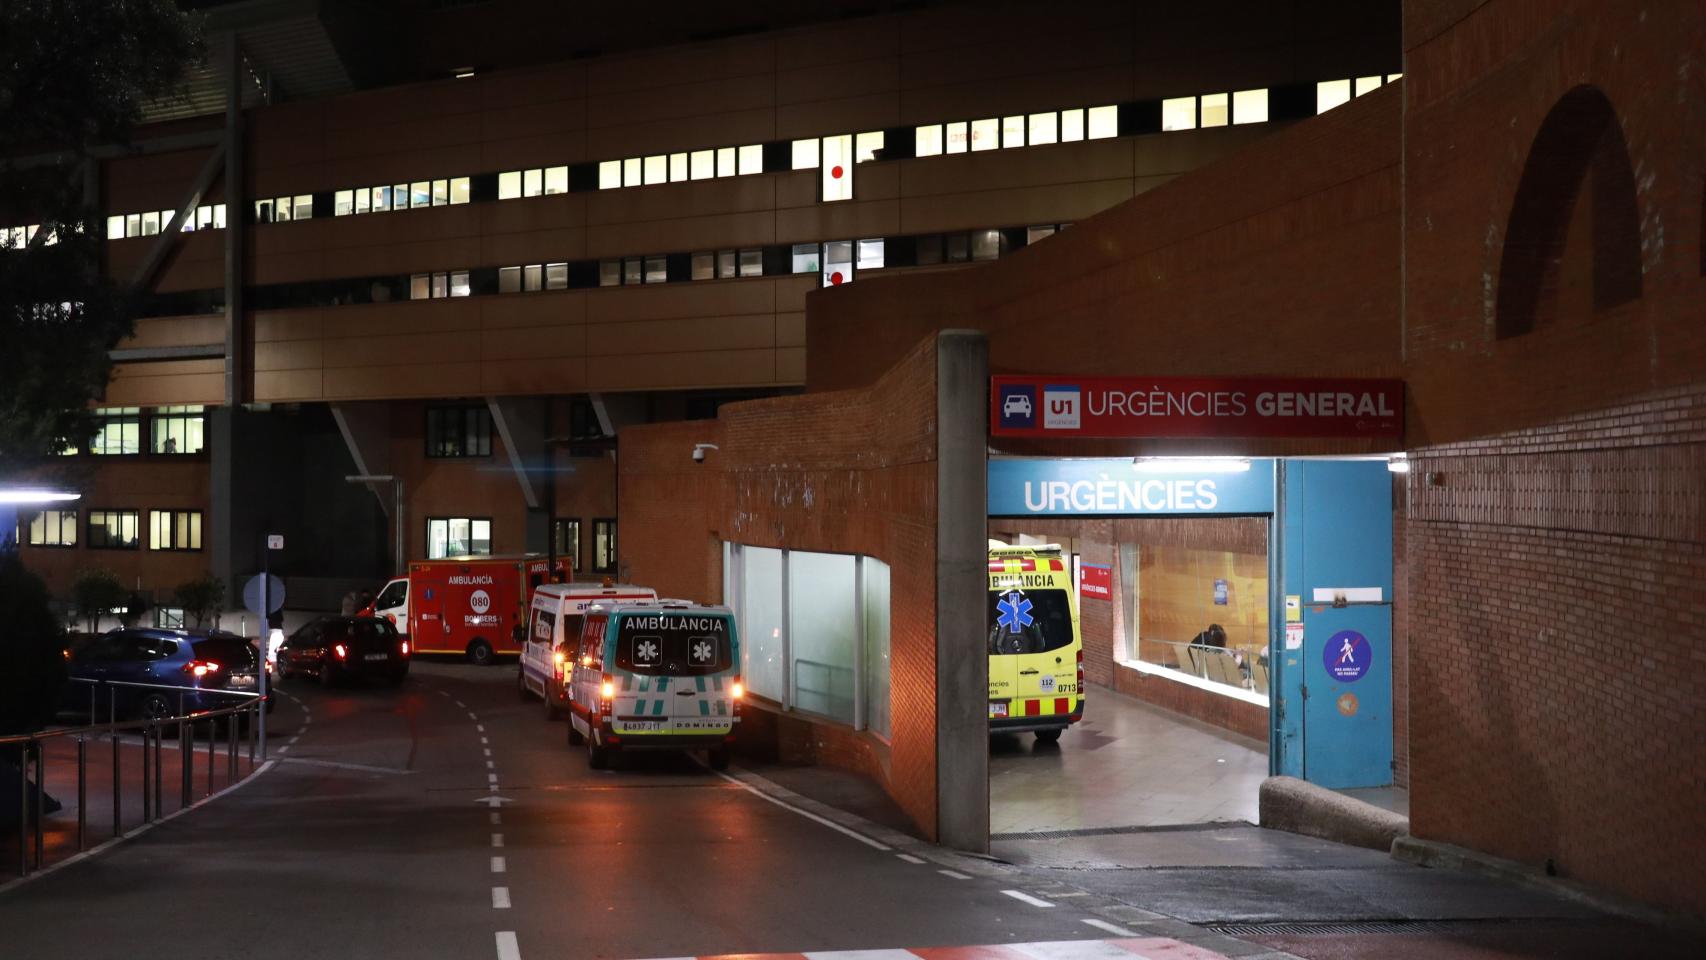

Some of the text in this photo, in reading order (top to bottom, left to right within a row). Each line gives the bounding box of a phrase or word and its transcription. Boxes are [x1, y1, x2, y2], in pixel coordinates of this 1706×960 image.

[1051, 400, 1073, 414] U1
[1088, 386, 1394, 416] URGÈNCIES GENERAL
[1025, 473, 1217, 511] URGÈNCIES
[472, 597, 489, 607] 080
[626, 616, 723, 631] AMBULÀNCIA
[988, 680, 1009, 688] ncies
[1057, 684, 1077, 693] 0713
